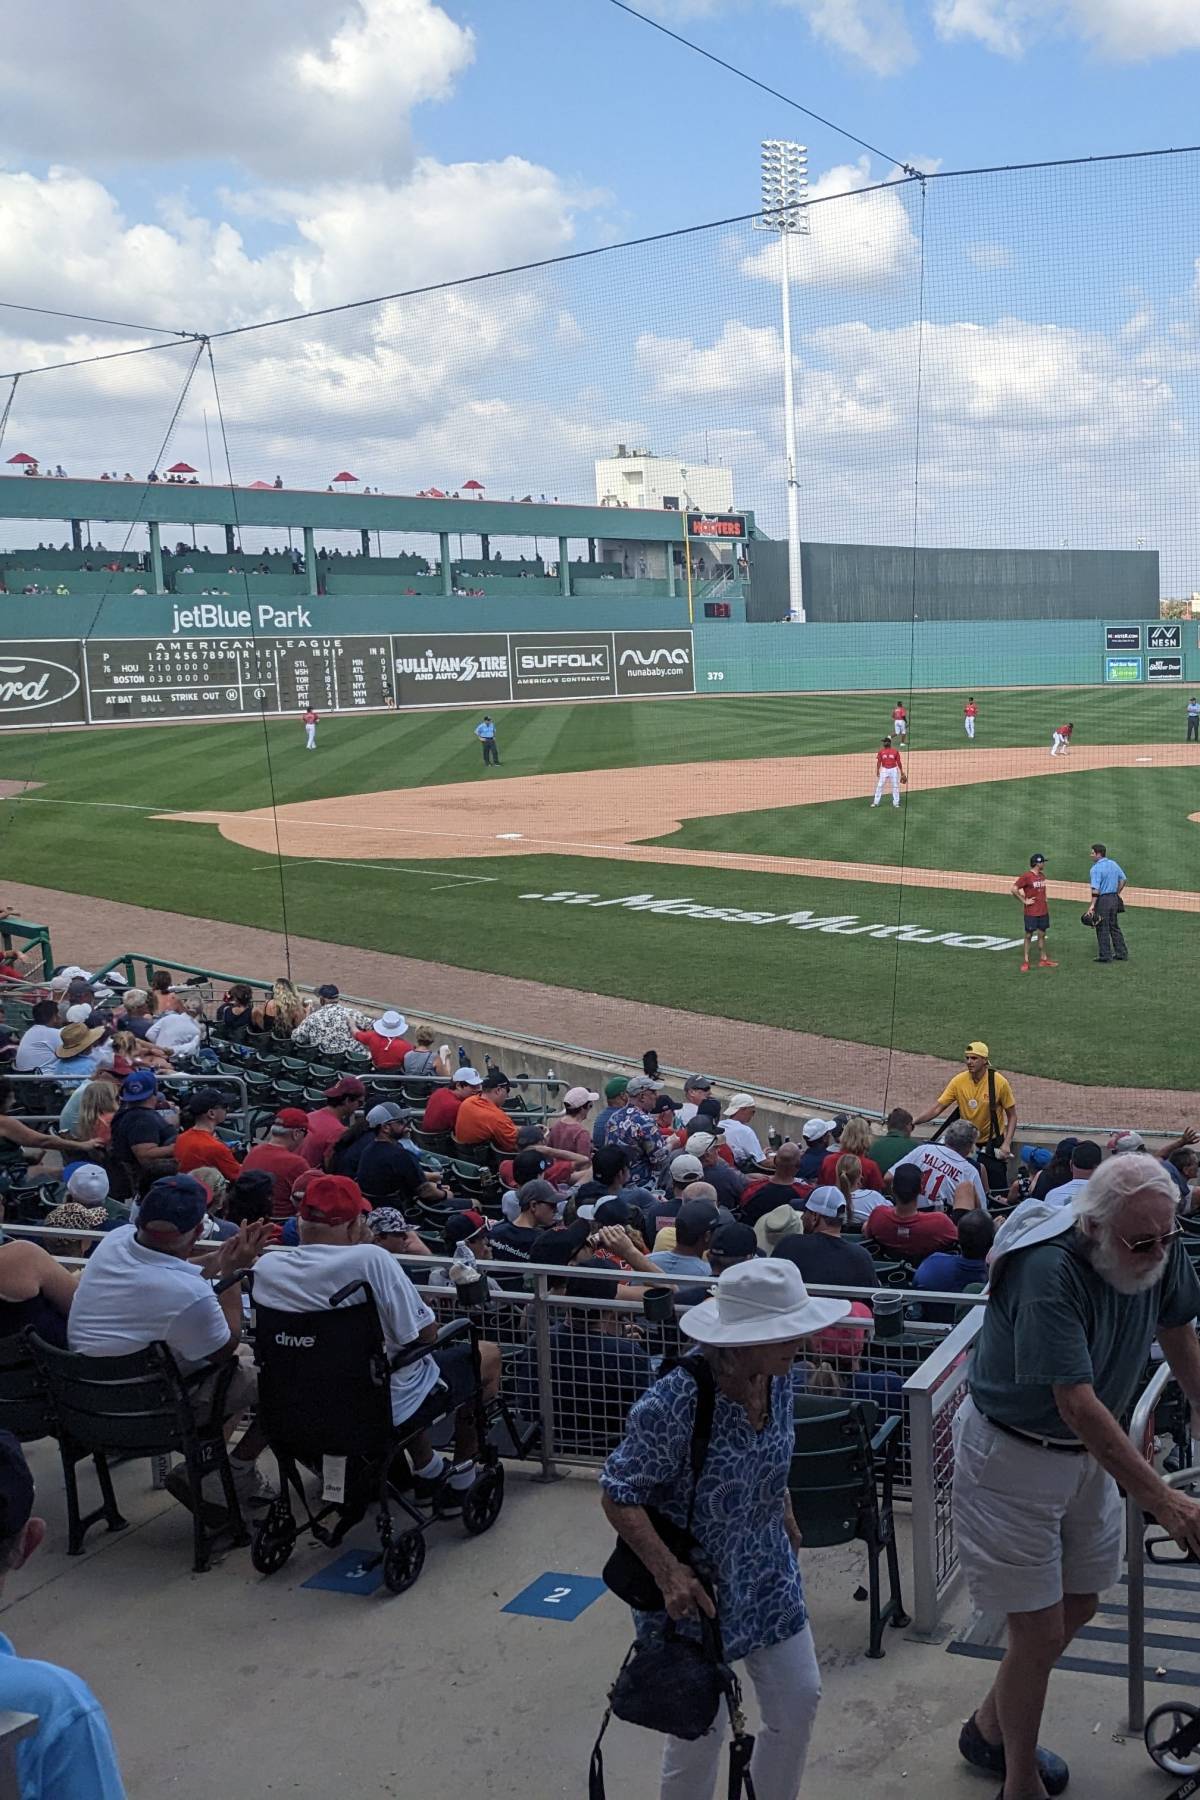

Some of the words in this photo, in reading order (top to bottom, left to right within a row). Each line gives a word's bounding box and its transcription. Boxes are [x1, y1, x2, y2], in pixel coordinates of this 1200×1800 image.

[172, 604, 252, 634] jetBlue
[258, 604, 313, 629] Park
[155, 641, 254, 651] AMERICAN
[275, 639, 342, 648] LEAGUE
[1151, 639, 1177, 647] NESN
[103, 653, 110, 661] P
[148, 652, 153, 660] 1
[156, 652, 162, 660] 2
[164, 652, 170, 660] 3
[174, 651, 181, 659] 4
[183, 651, 190, 659] 5
[191, 651, 198, 659] 6
[202, 651, 208, 659] 7
[209, 651, 216, 659] 8
[218, 651, 224, 659] 9
[226, 650, 236, 659] 10
[243, 650, 249, 658] R
[281, 649, 287, 657] P
[323, 649, 329, 657] R
[338, 648, 344, 656] P
[380, 647, 386, 655] R
[521, 654, 604, 669] SUFFOLK
[619, 648, 689, 666] nuna
[294, 660, 307, 668] STL
[395, 656, 460, 674] SULLIVAN
[479, 656, 507, 671] TIRE
[415, 673, 434, 681] AND
[435, 672, 458, 680] AUTO
[476, 671, 508, 679] SERVICE
[627, 667, 684, 678] nunababy.com
[707, 672, 724, 681] 379
[113, 675, 145, 684] BOSTON
[517, 677, 559, 685] AMERICA'S
[561, 675, 610, 683] CONTRACTOR
[105, 696, 117, 704] AT
[117, 695, 133, 704] BAT
[141, 695, 162, 703] BALL
[170, 693, 199, 702] STRIKE
[202, 692, 220, 700] OUT
[297, 692, 309, 700] PIT
[590, 893, 1047, 951] MassMutual
[922, 1152, 963, 1183] MALZONE
[920, 1167, 946, 1201] 11
[275, 1332, 315, 1348] drive
[543, 1587, 572, 1604] 2
